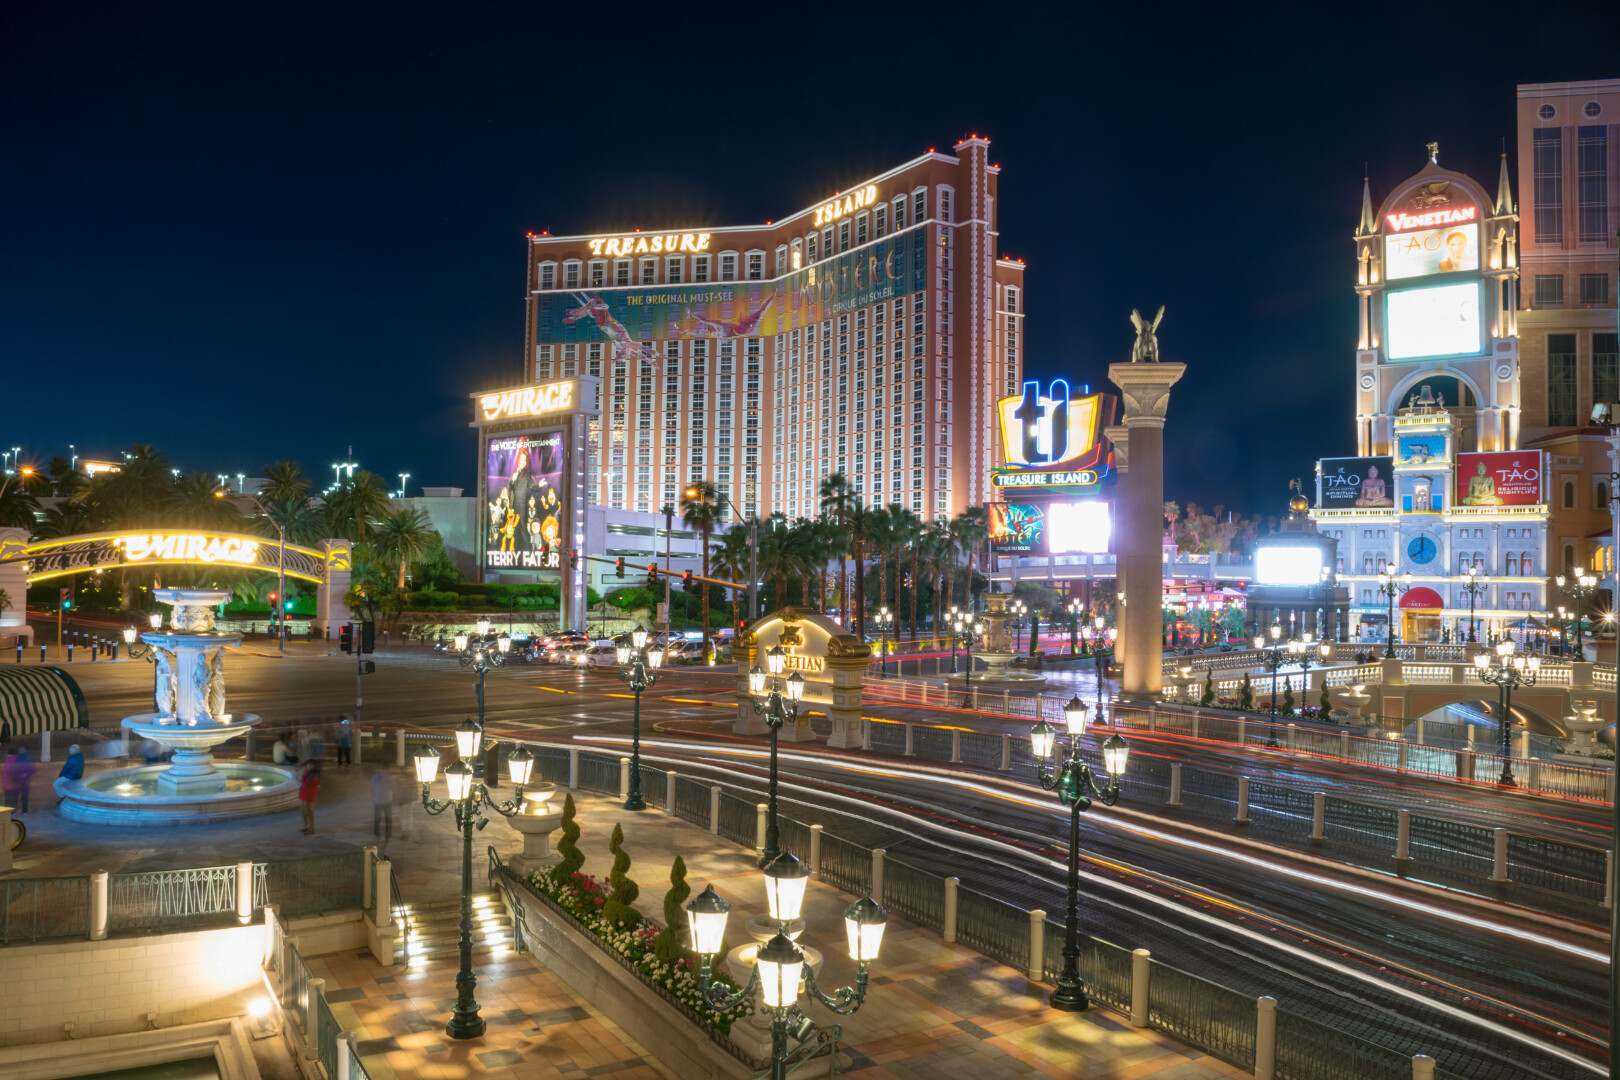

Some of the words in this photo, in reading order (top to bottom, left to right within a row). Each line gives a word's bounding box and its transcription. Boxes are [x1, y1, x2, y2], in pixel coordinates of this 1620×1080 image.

[814, 184, 877, 226] ISLAND
[1387, 207, 1475, 232] VENETIAN
[589, 233, 711, 256] TREASURE
[1390, 234, 1442, 256] TAO
[627, 296, 644, 306] THE
[646, 294, 688, 304] ORIGINAL
[690, 292, 734, 302] MUST-SEE
[832, 298, 856, 313] CIRQUE
[858, 294, 868, 304] DU
[870, 287, 894, 302] SOLEIL
[485, 384, 572, 420] MIRAGE
[500, 440, 517, 450] VOICE
[524, 438, 560, 448] ENTERTAINMENT
[998, 474, 1046, 486] TREASURE
[1052, 473, 1090, 484] ISLAND
[1323, 474, 1360, 487] TAO
[1496, 469, 1538, 482] TAO
[126, 534, 258, 562] MIRAGE
[487, 551, 521, 566] TERRY
